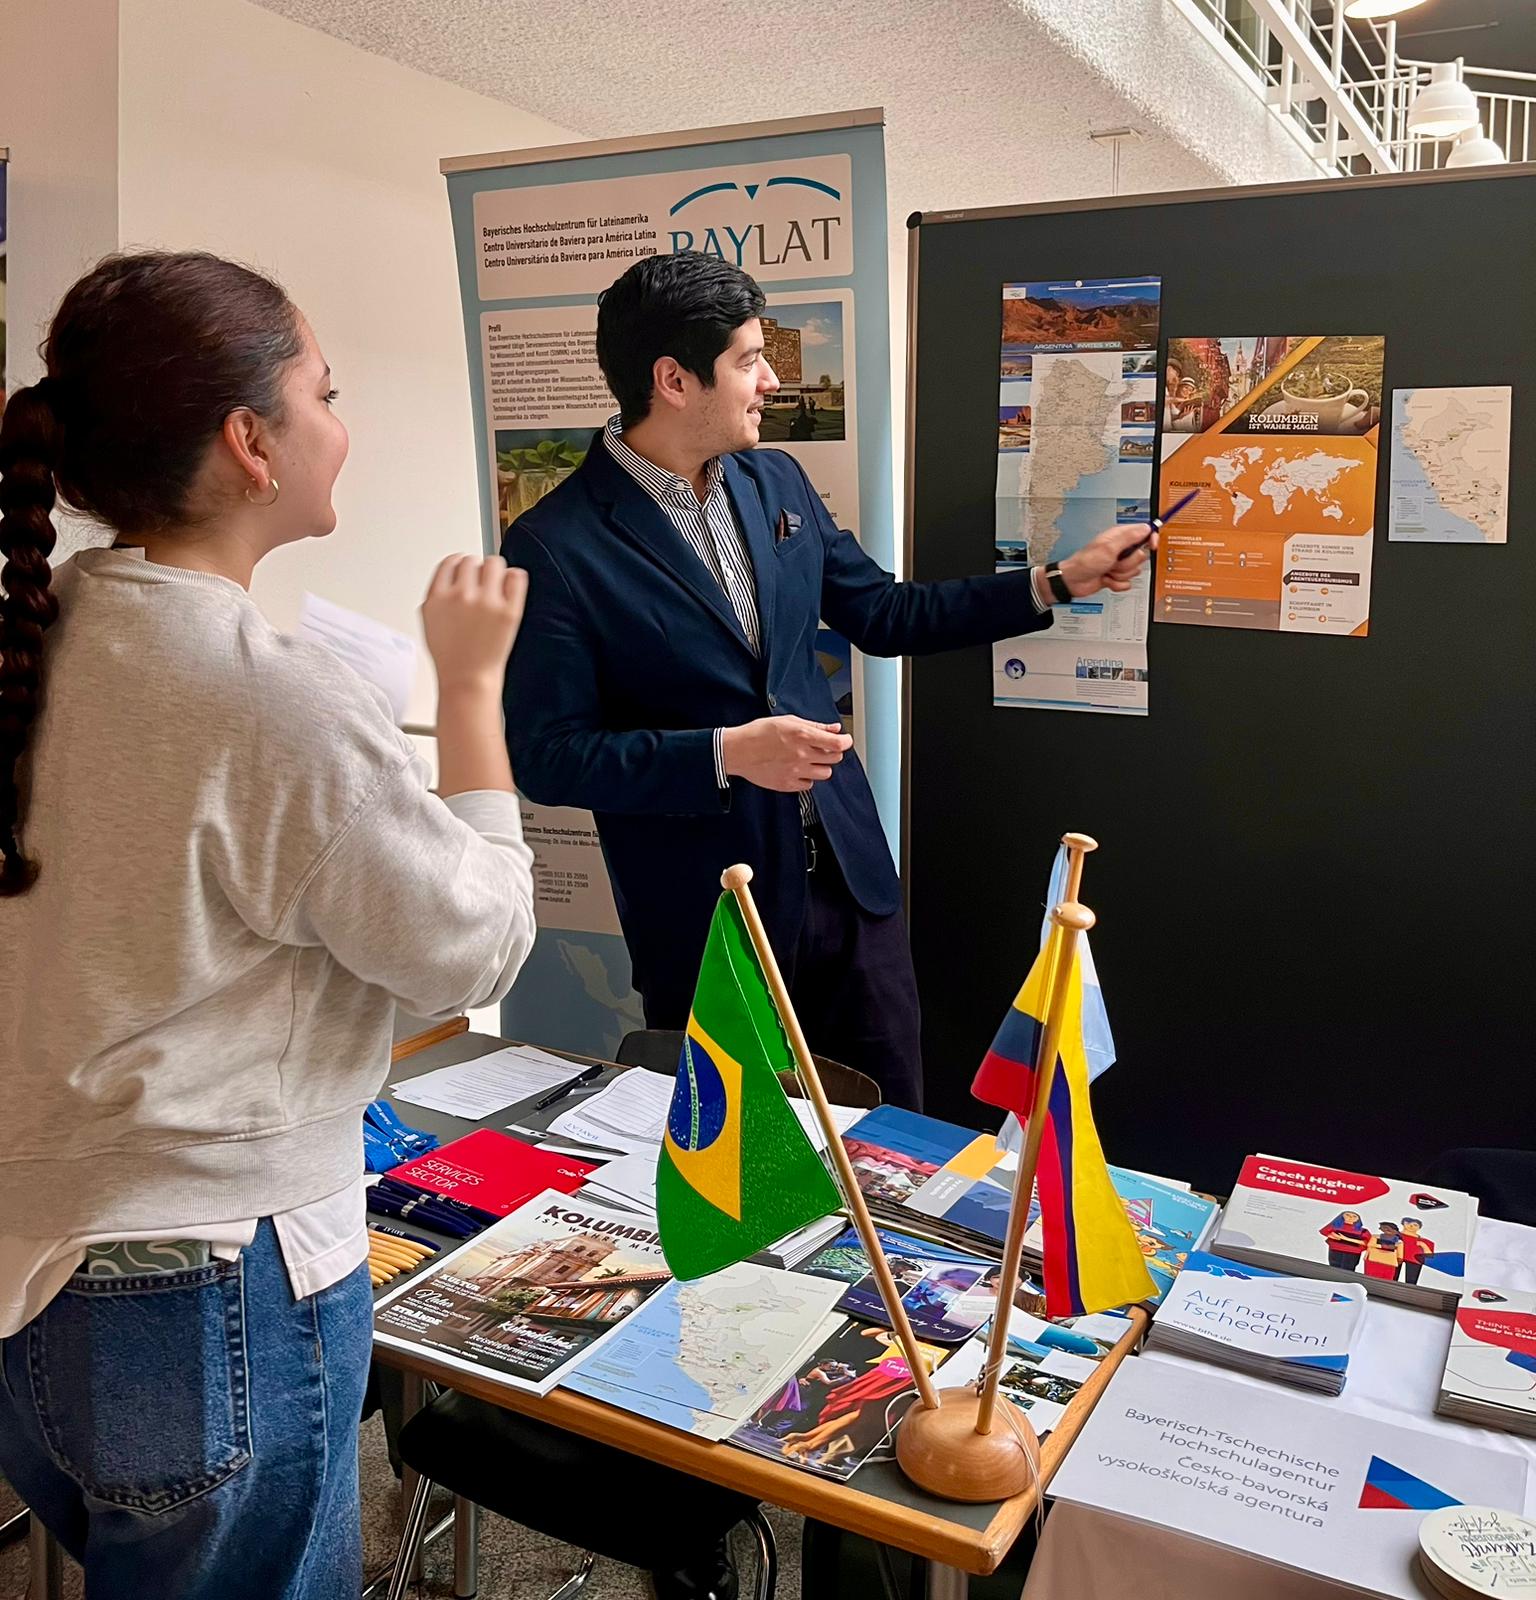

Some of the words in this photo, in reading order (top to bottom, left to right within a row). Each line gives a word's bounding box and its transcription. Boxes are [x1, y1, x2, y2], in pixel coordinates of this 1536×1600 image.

[483, 225, 522, 238] Bayerisches
[523, 220, 585, 233] Hochschulzentrum
[587, 218, 597, 227] für
[599, 214, 649, 226] Lateinamerika
[484, 242, 504, 252] Centro
[506, 238, 548, 250] Universitario
[550, 237, 558, 247] de
[560, 235, 585, 246] Baviera
[587, 233, 603, 246] para
[605, 231, 632, 242] América
[634, 230, 656, 239] Latina
[668, 217, 840, 266] BAYLAT
[484, 258, 505, 268] Centro
[506, 254, 549, 266] Universitário
[550, 253, 559, 263] da
[560, 252, 586, 261] Baviera
[588, 250, 604, 262] para
[606, 248, 633, 258] América
[635, 246, 657, 255] Latina
[489, 324, 501, 332] Profil
[1249, 414, 1319, 424] KOLUMBIEN
[1076, 656, 1124, 670] Argentina
[690, 1086, 698, 1149] PROGRESSO
[405, 1167, 458, 1190] SECTOR
[422, 1160, 484, 1185] SERVICES
[1256, 1173, 1337, 1196] Education
[1258, 1165, 1308, 1182] Czech
[1309, 1175, 1365, 1192] Higher
[535, 1215, 559, 1226] IST
[568, 1226, 619, 1244] WAHRE
[629, 1243, 663, 1254] MAG
[440, 1274, 481, 1292] KULTUR
[391, 1305, 442, 1325] STRÄNDE
[1187, 1289, 1232, 1308] Auf
[1236, 1304, 1296, 1326] nach
[1183, 1300, 1328, 1347] Tschechien!
[1474, 1324, 1502, 1334] Study
[1476, 1320, 1511, 1331] THINK
[469, 1334, 555, 1363] Reiseinformationen
[1125, 1408, 1340, 1479] Bayerisch-Tschechische
[1160, 1432, 1336, 1492] Hochschulagentur
[1098, 1454, 1229, 1497] vysokoškolská
[1234, 1491, 1324, 1528] agentura
[1177, 1456, 1328, 1512] Česko-bavorská
